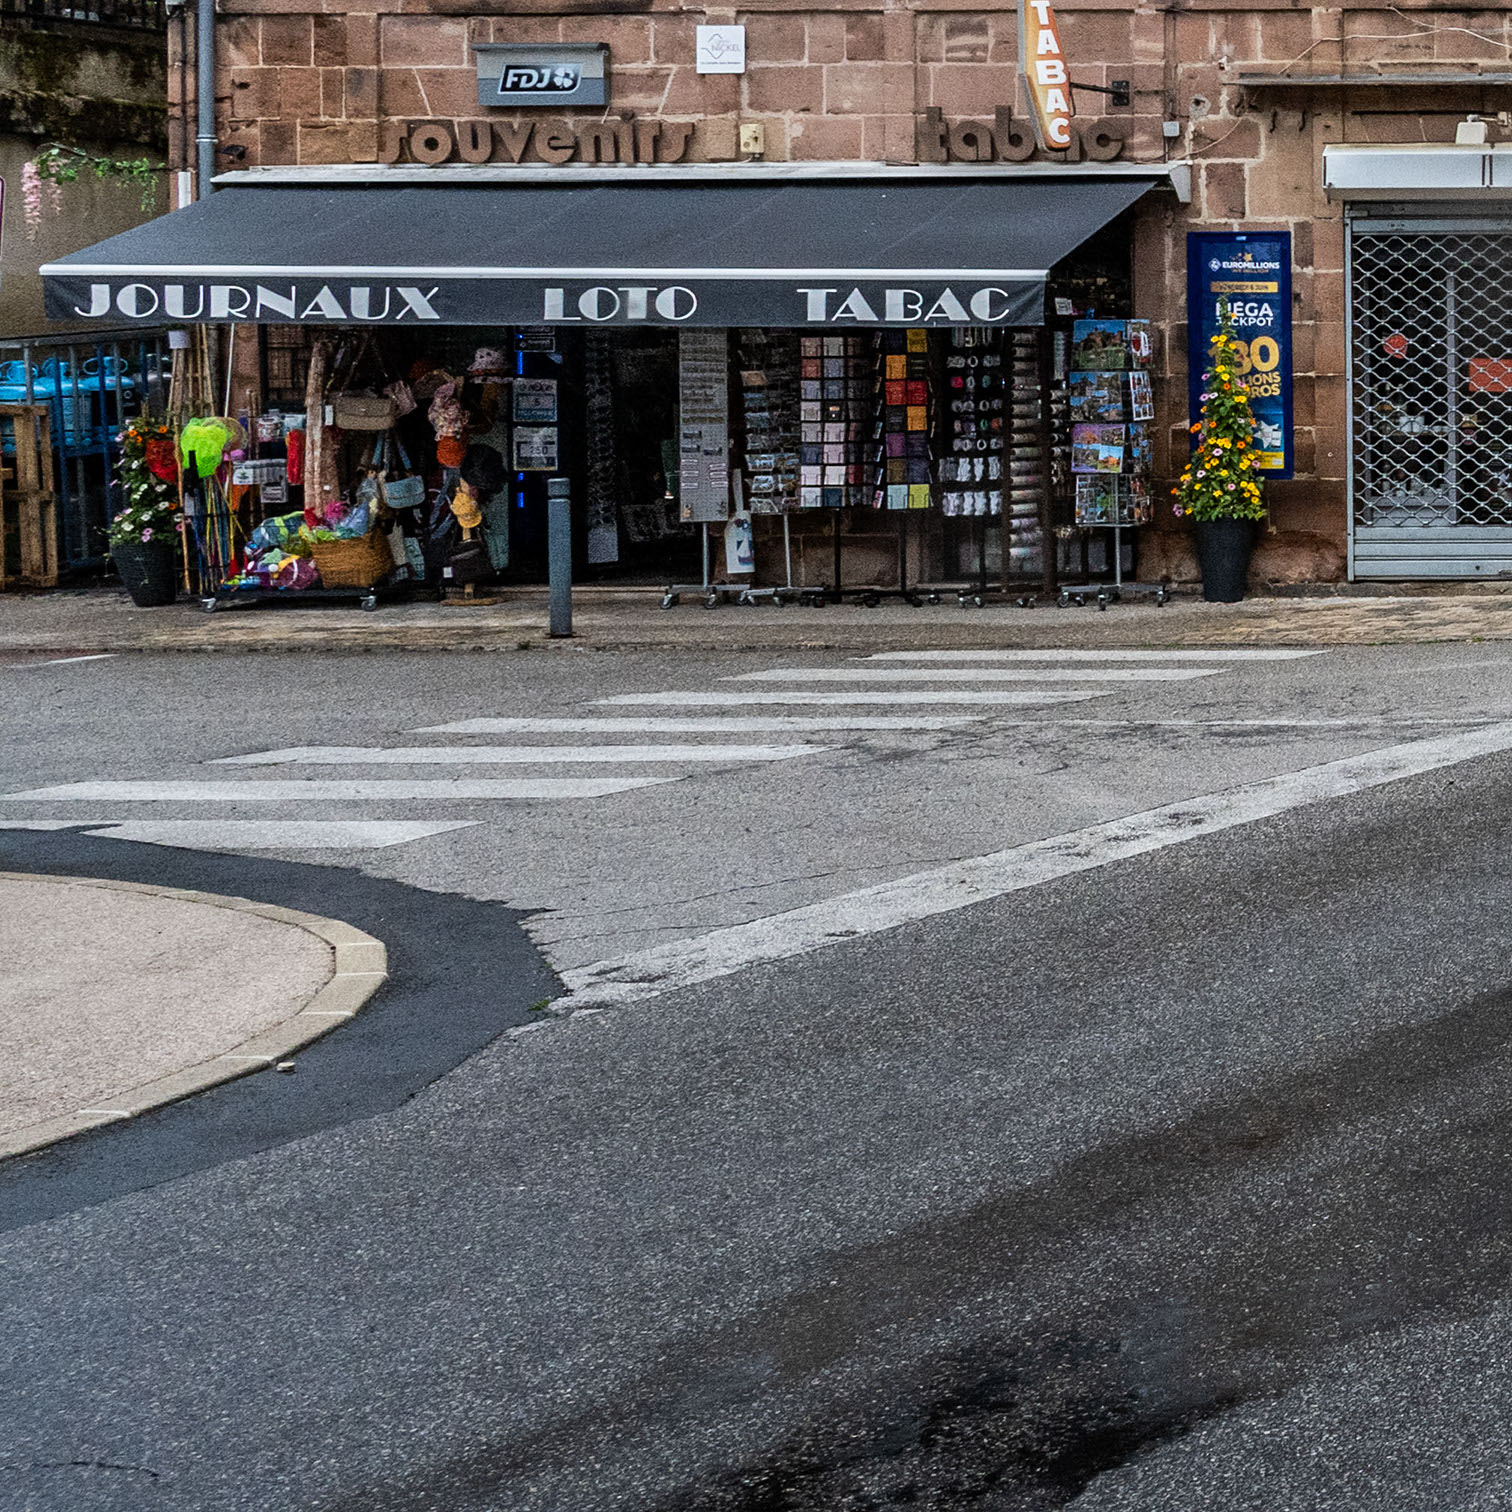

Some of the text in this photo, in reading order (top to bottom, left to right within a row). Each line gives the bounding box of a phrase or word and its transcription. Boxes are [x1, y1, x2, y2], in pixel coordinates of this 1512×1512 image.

[505, 68, 551, 89] FDJ
[1030, 0, 1071, 144] TABAC
[378, 109, 695, 164] souvenirs
[1222, 261, 1280, 269] EUROMILLIONS
[74, 283, 1010, 322] JOURNAUX LOTO TABAC
[1215, 317, 1274, 326] JCKPOT
